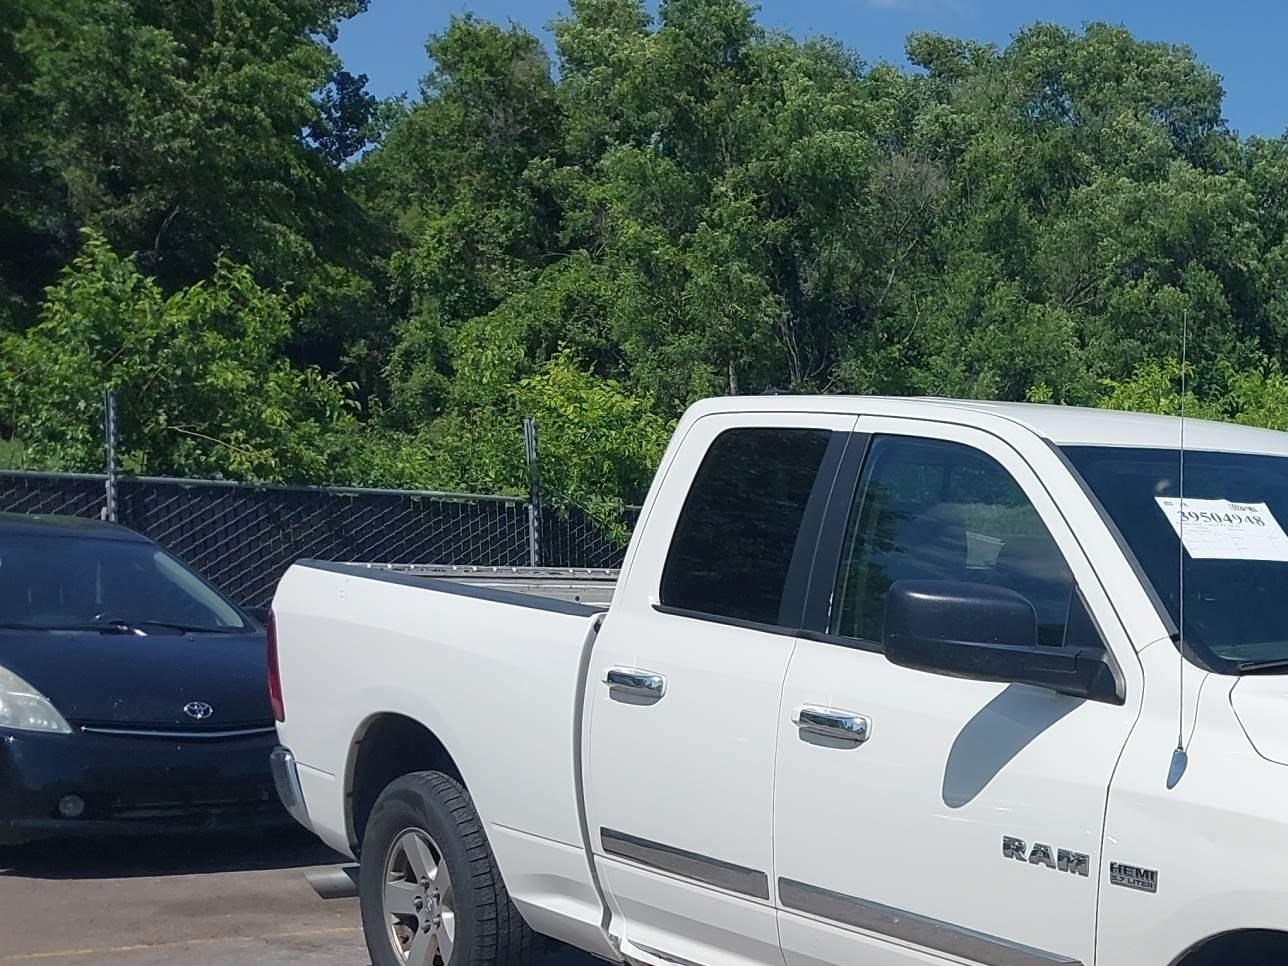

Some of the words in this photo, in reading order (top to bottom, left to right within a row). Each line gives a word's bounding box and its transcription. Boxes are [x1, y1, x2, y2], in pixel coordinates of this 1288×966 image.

[1177, 510, 1266, 527] 39504948
[1002, 835, 1090, 878] RAM
[1110, 861, 1156, 882] HEMI
[1127, 877, 1153, 889] LITER
